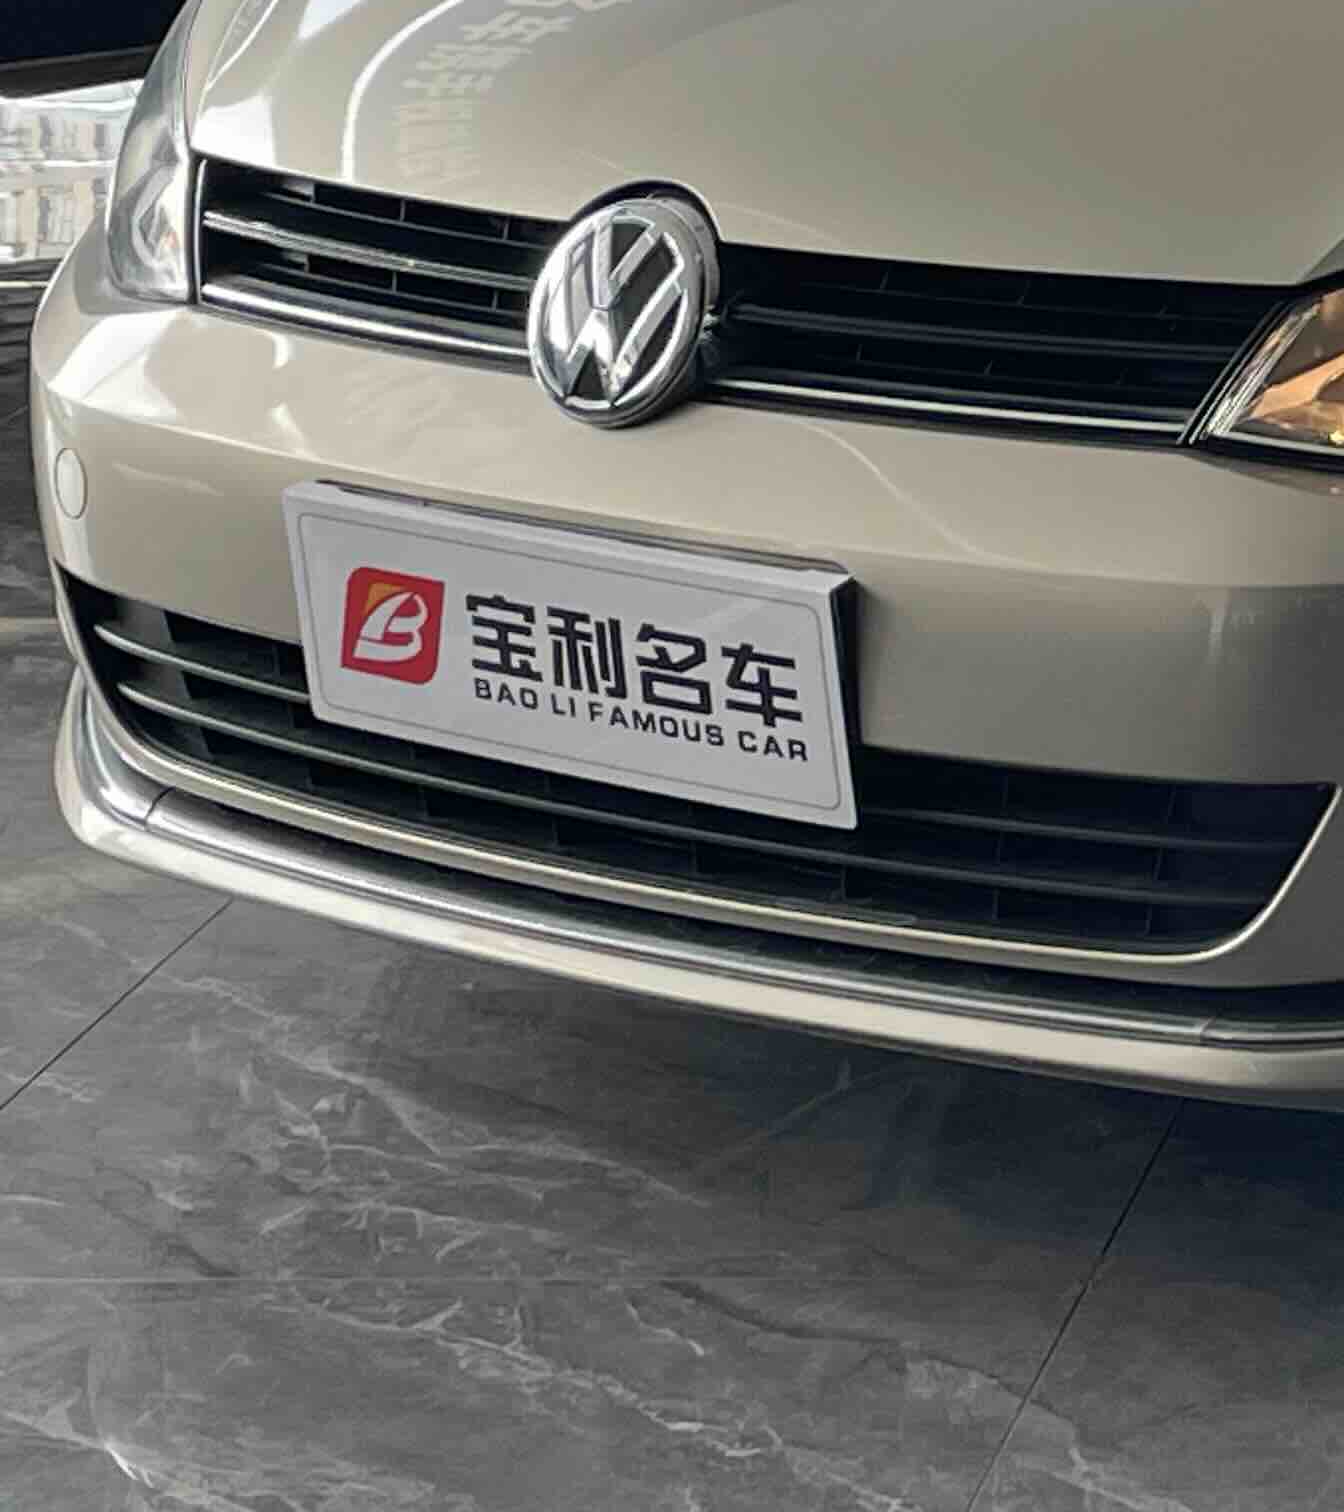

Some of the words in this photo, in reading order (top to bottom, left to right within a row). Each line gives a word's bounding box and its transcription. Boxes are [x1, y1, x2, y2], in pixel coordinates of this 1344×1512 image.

[465, 594, 803, 728] 宝利名车
[474, 678, 539, 713] BAO
[551, 694, 577, 718] LI
[589, 701, 725, 746] FAMOUS
[739, 730, 809, 762] CAR
